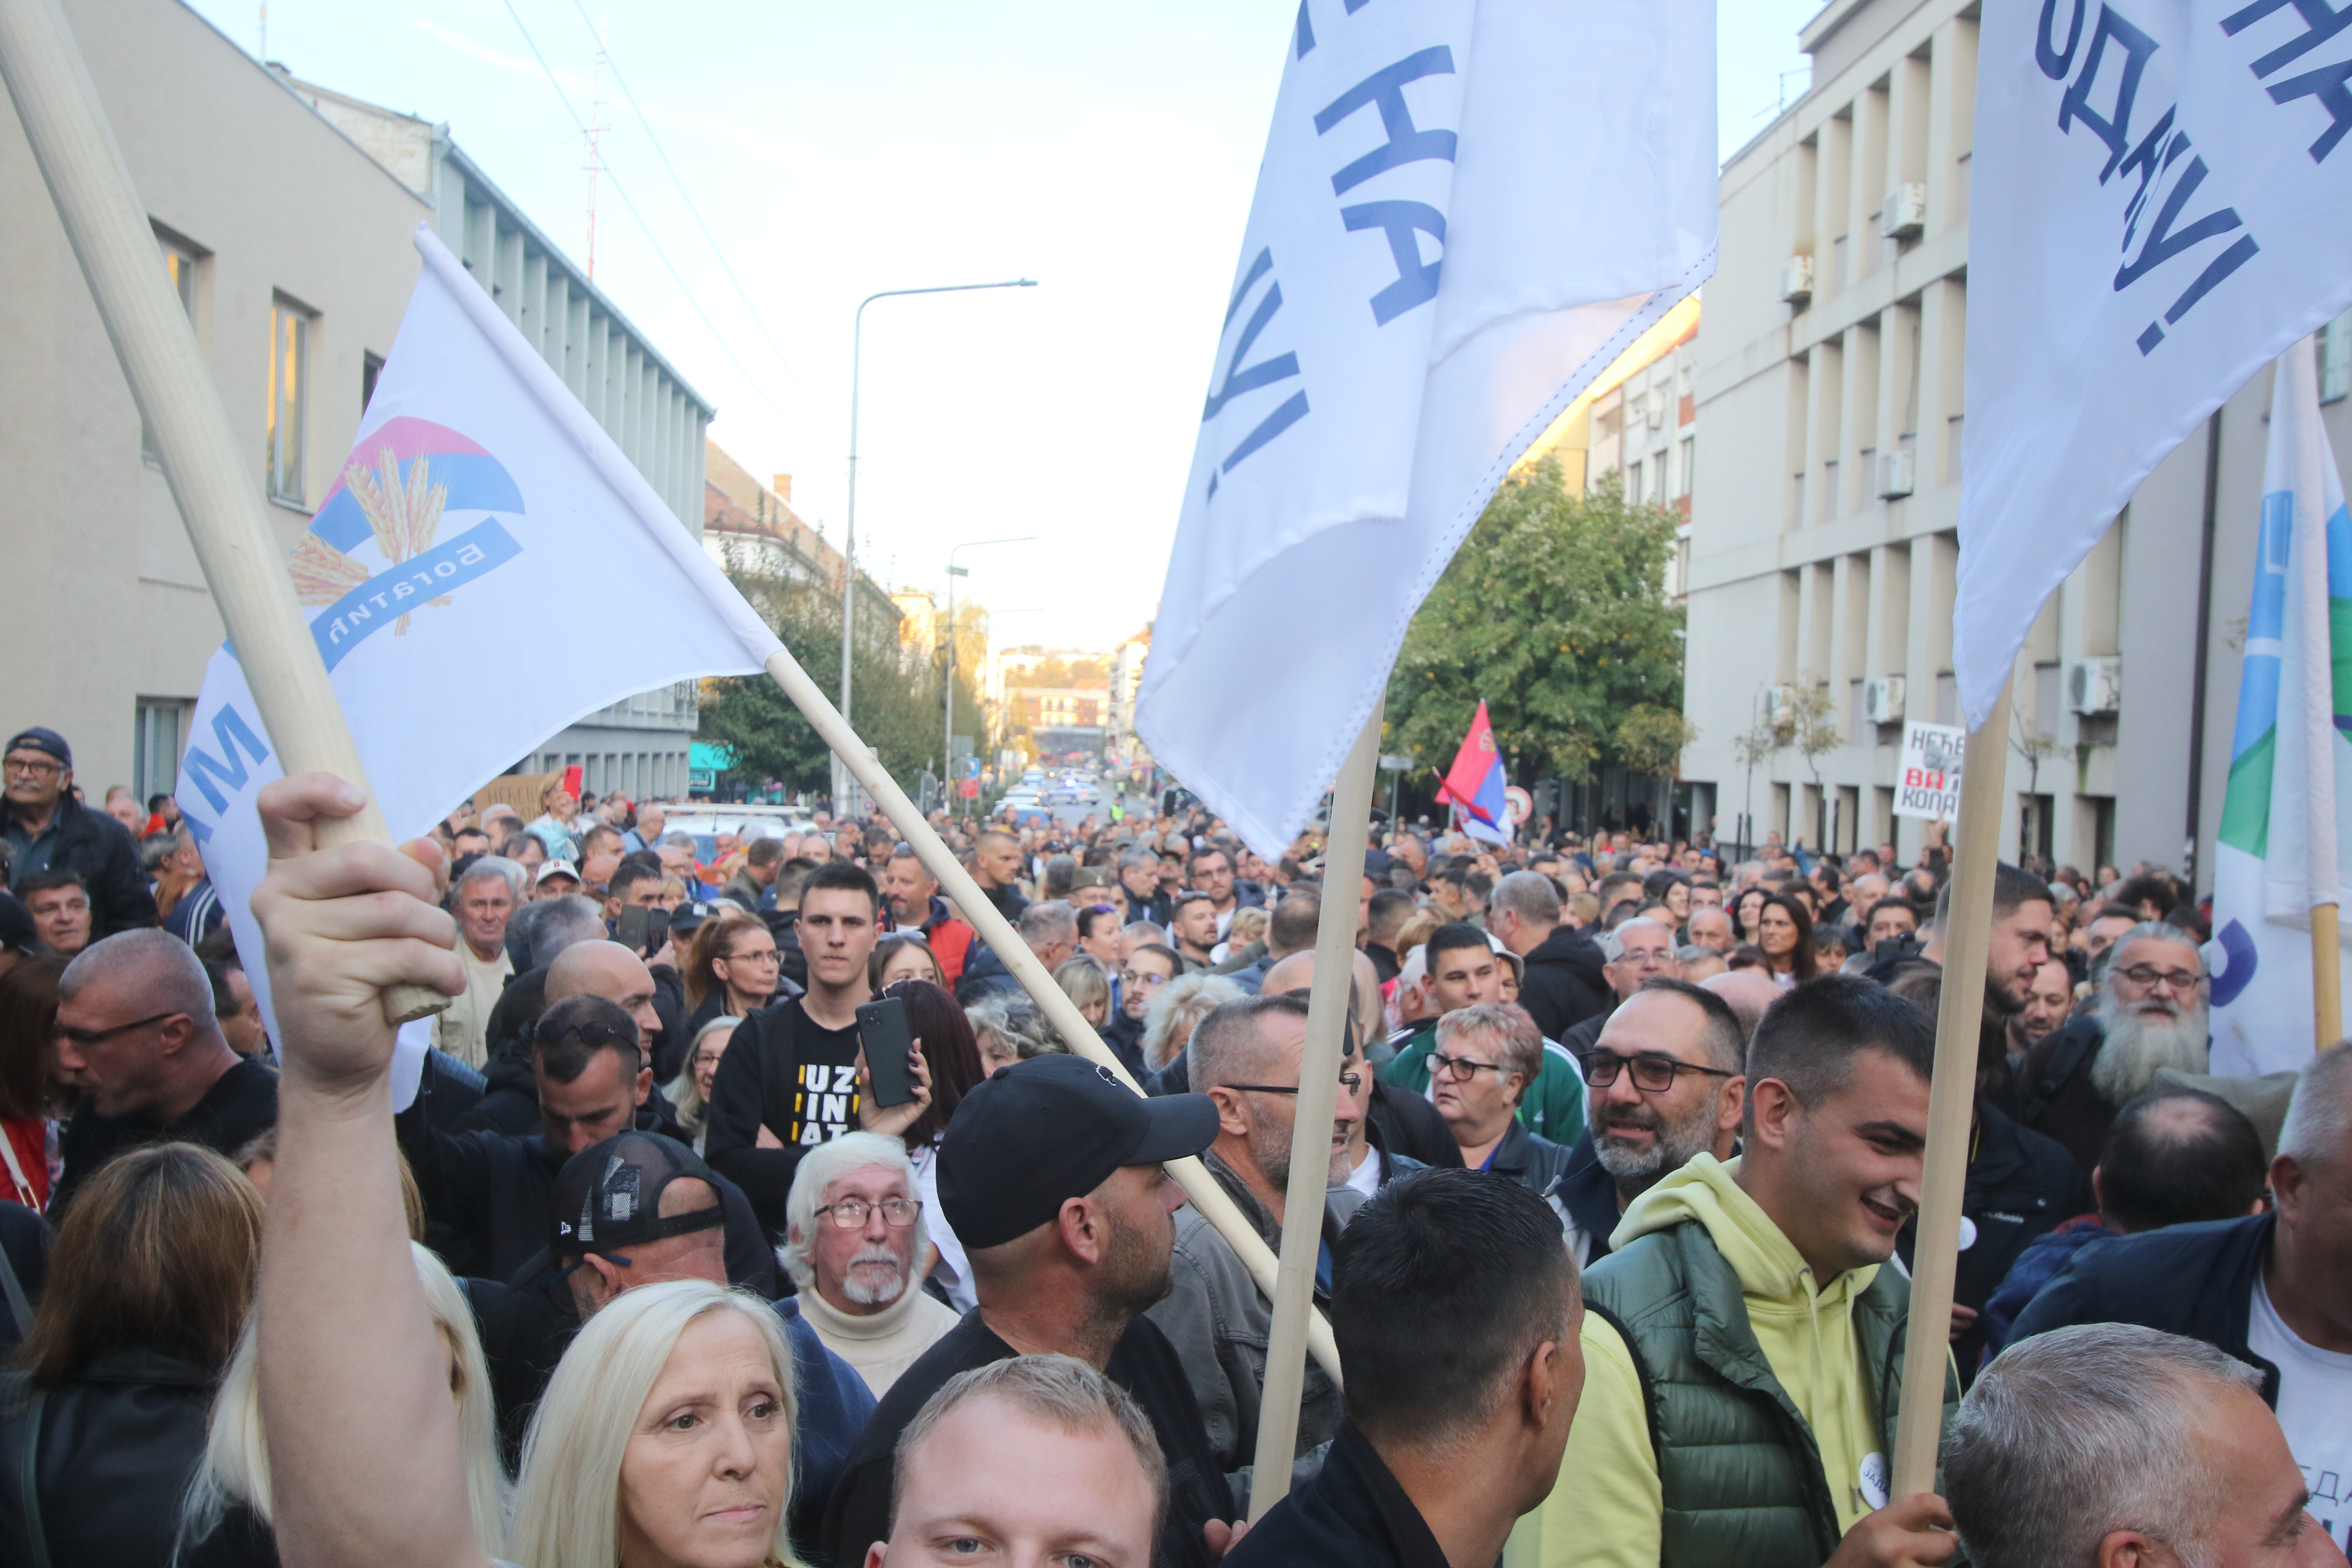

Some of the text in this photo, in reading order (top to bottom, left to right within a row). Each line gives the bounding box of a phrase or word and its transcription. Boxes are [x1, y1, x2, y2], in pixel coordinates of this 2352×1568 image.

[1313, 44, 1458, 328] НА
[806, 1064, 856, 1093] UZ
[806, 1092, 847, 1122] IN
